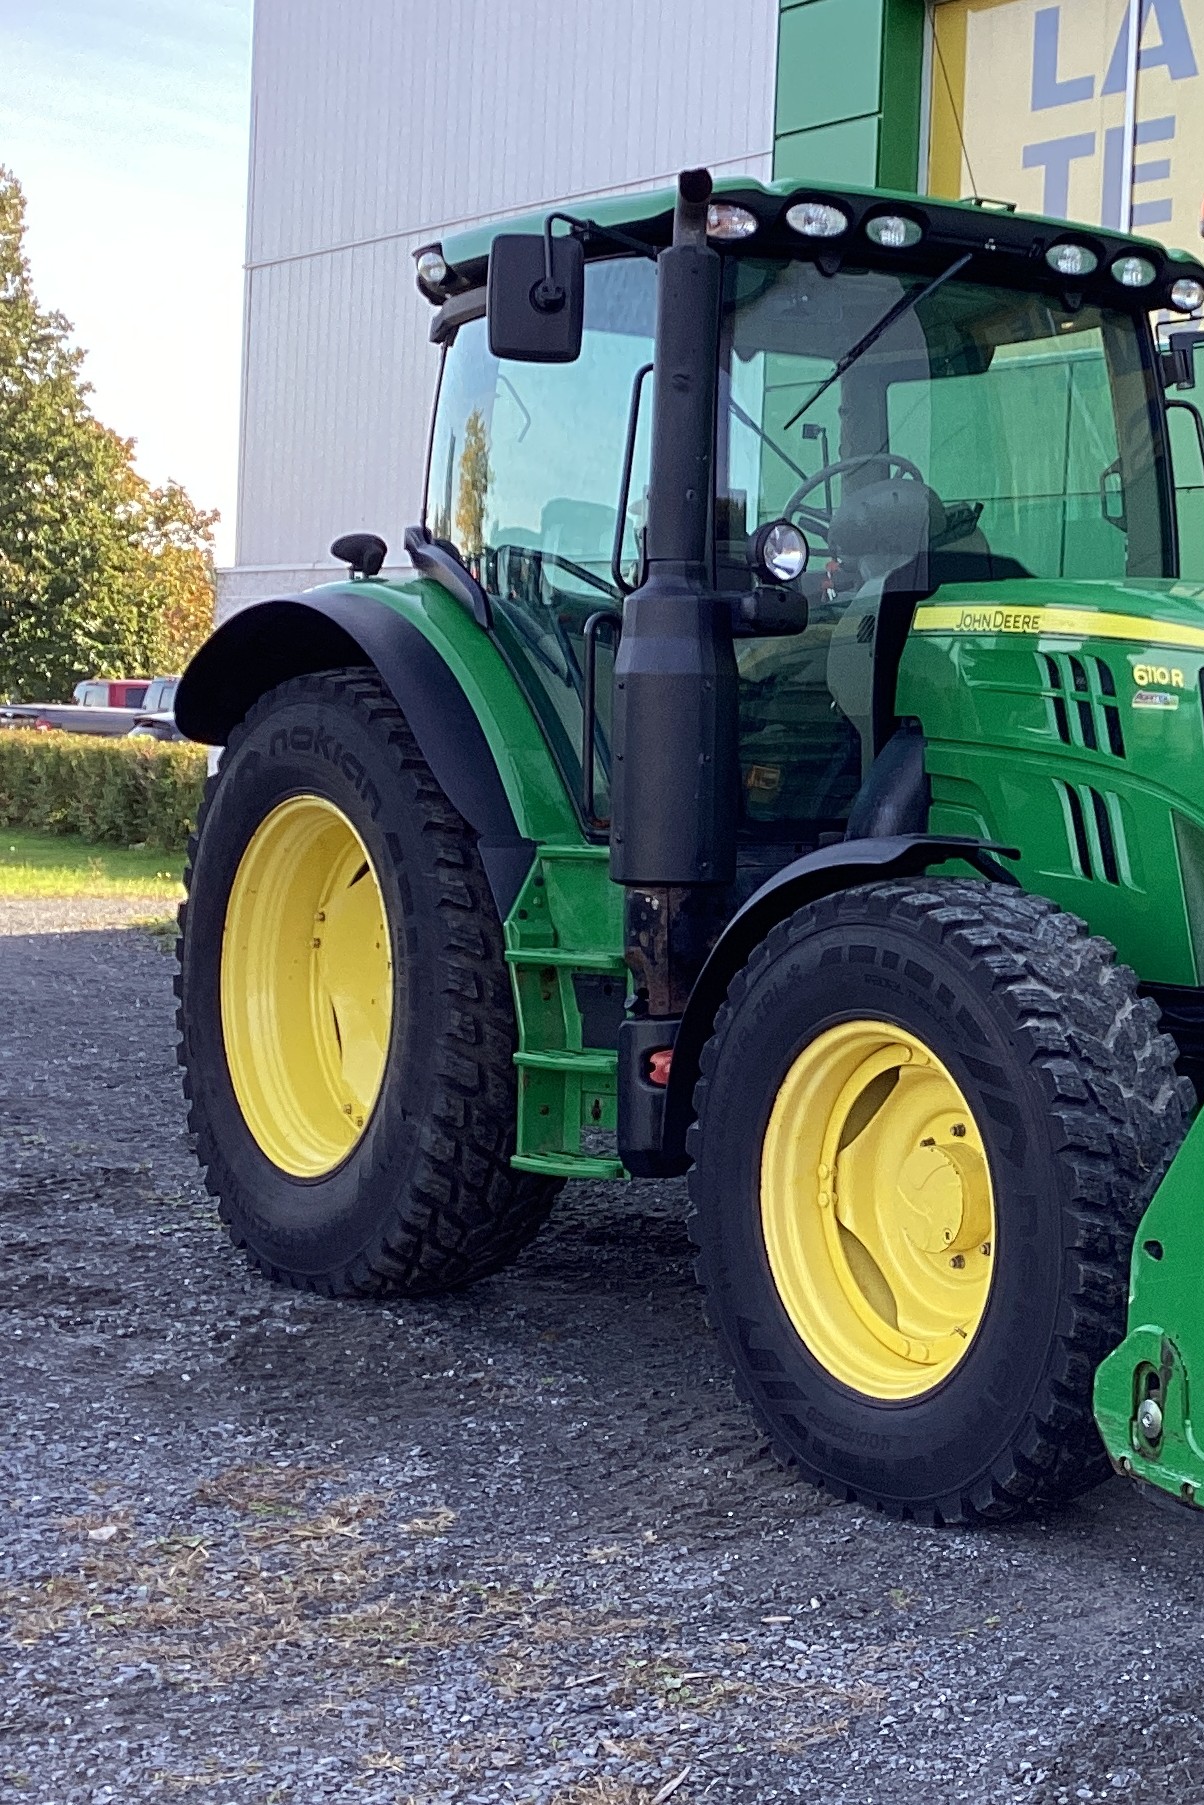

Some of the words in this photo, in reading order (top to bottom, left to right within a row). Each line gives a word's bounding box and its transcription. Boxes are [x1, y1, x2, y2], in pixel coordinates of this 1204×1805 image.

[1030, 0, 1199, 111] LA
[1022, 115, 1176, 228] TE
[956, 610, 992, 628] JOHN
[993, 610, 1041, 630] DEERE
